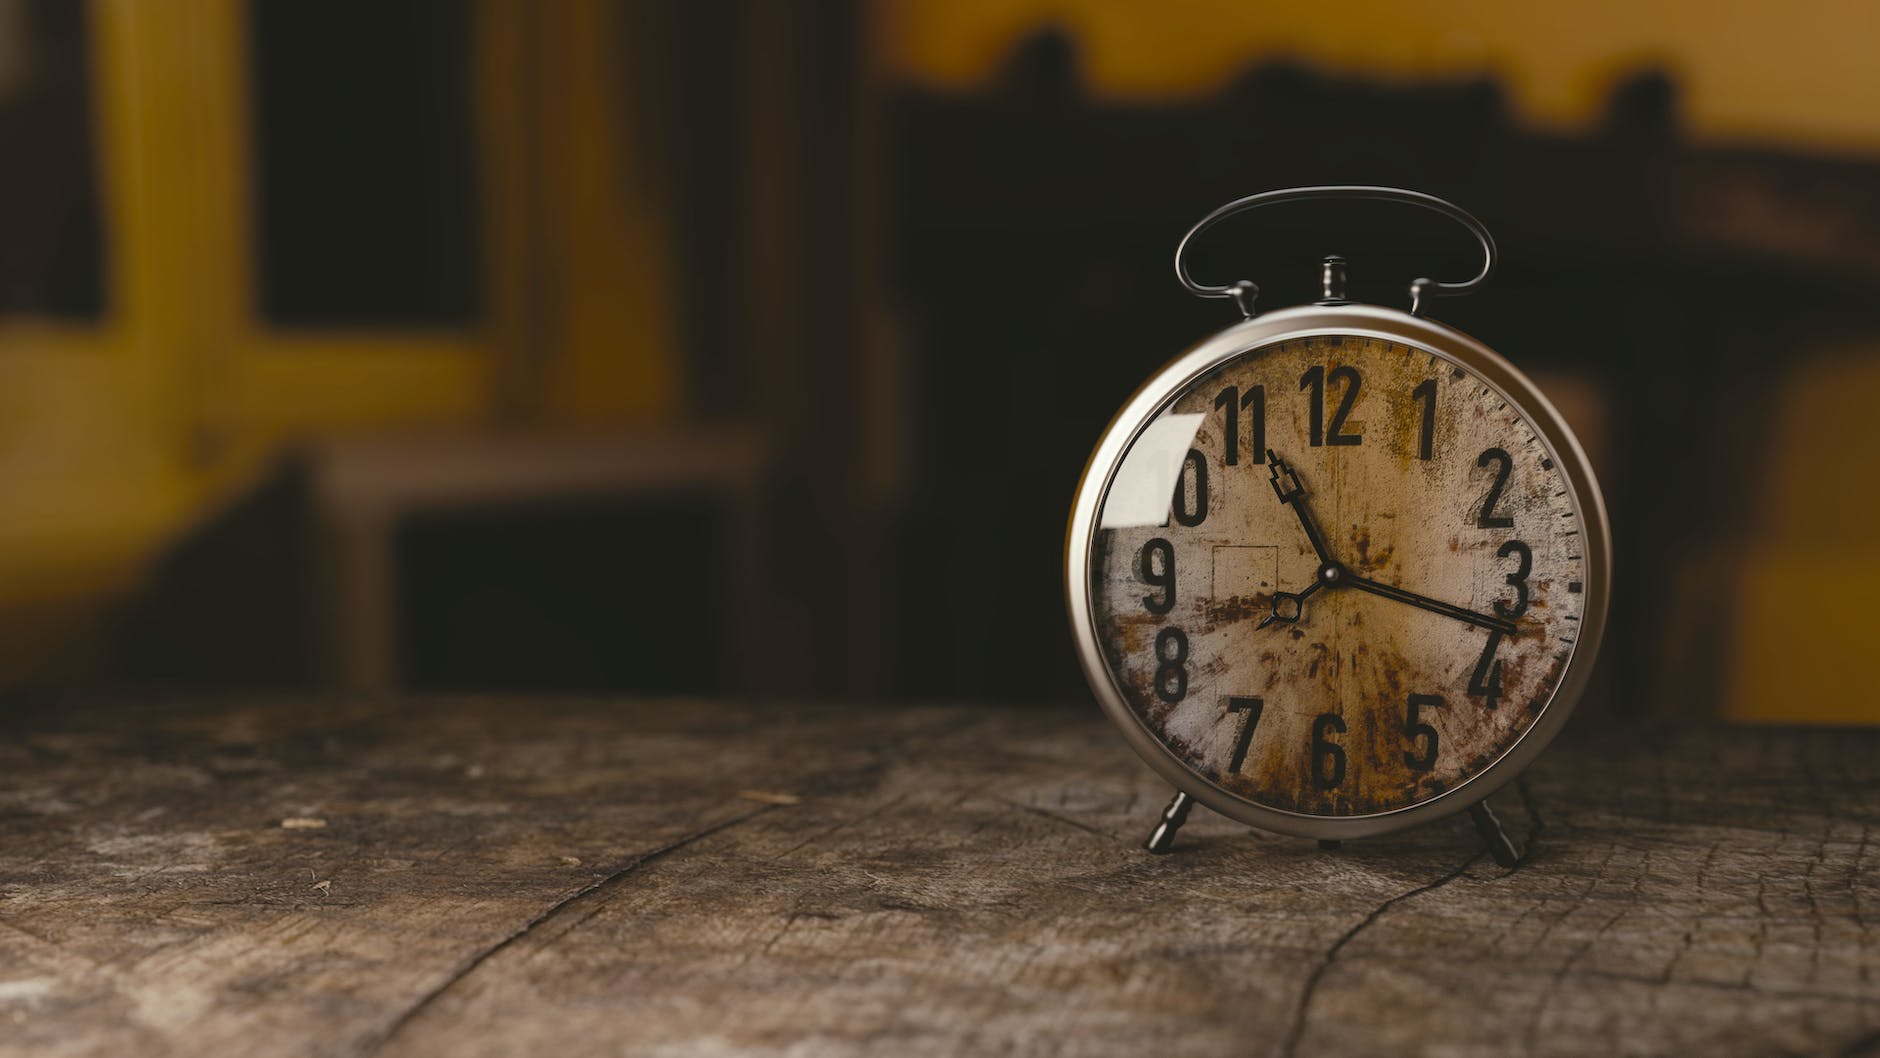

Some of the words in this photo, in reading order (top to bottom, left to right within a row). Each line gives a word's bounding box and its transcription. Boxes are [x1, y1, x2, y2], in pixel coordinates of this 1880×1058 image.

[1214, 386, 1266, 465] 11
[1299, 366, 1362, 447] 12
[1412, 380, 1438, 460] 1
[1477, 448, 1514, 528] 2
[1141, 539, 1176, 614] 9
[1494, 541, 1533, 619] 3
[1155, 628, 1189, 702] 8
[1467, 625, 1503, 710] 4
[1227, 697, 1264, 773] 7
[1312, 714, 1347, 790] 6
[1405, 695, 1442, 770] 5
